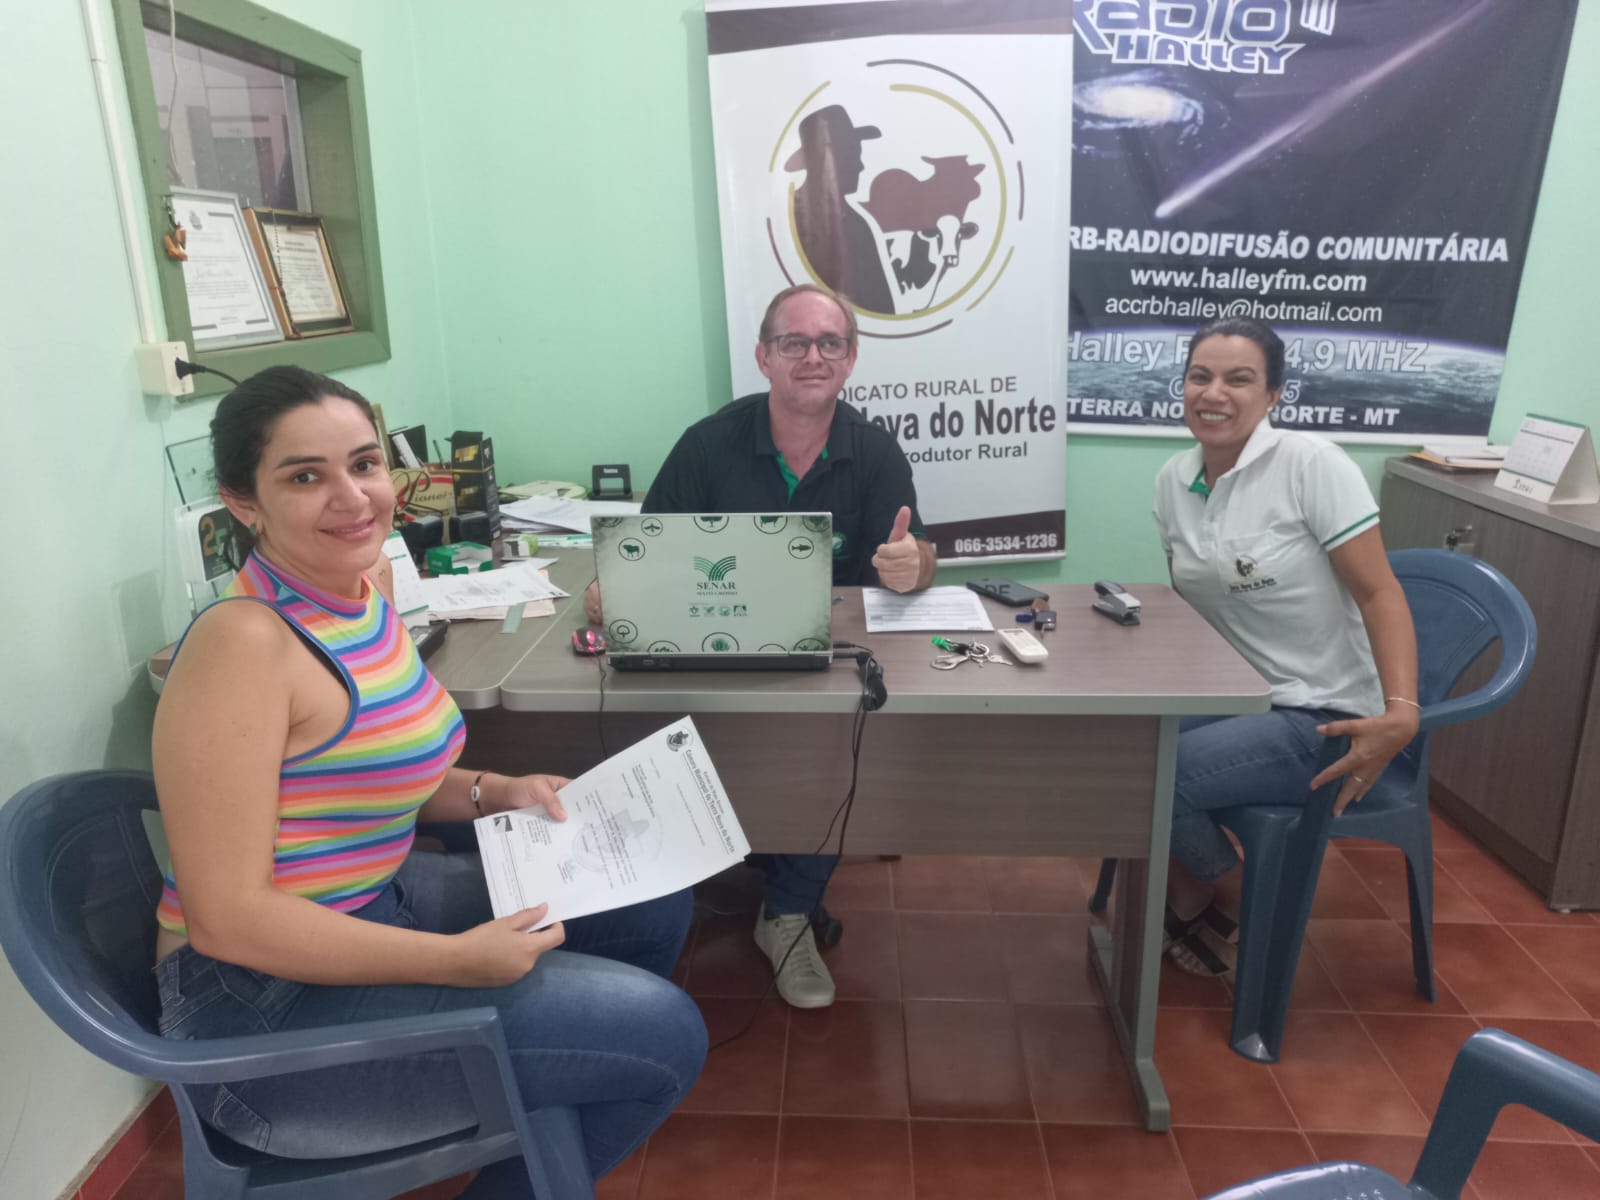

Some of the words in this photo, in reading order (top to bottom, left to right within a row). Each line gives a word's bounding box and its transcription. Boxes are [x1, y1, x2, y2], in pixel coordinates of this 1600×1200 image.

[1112, 33, 1306, 74] HALLEY
[1316, 232, 1508, 262] COMUNITÁRIA
[1130, 267, 1367, 295] www.halleyfm.com
[1105, 295, 1383, 323] accrbhalley@hotmail.com
[1284, 338, 1336, 374] 4,9
[1345, 340, 1429, 373] MHZ
[838, 384, 908, 402] DICATO
[915, 379, 984, 398] RURAL
[991, 376, 1016, 394] DE
[929, 401, 964, 439] do
[975, 396, 1056, 436] Norte
[1067, 398, 1143, 417] TERRA
[1151, 401, 1185, 419] NO
[1364, 408, 1400, 426] MT
[978, 441, 1027, 460] Rural
[955, 533, 1057, 553] 066-3534-1236
[696, 582, 736, 590] SENAR
